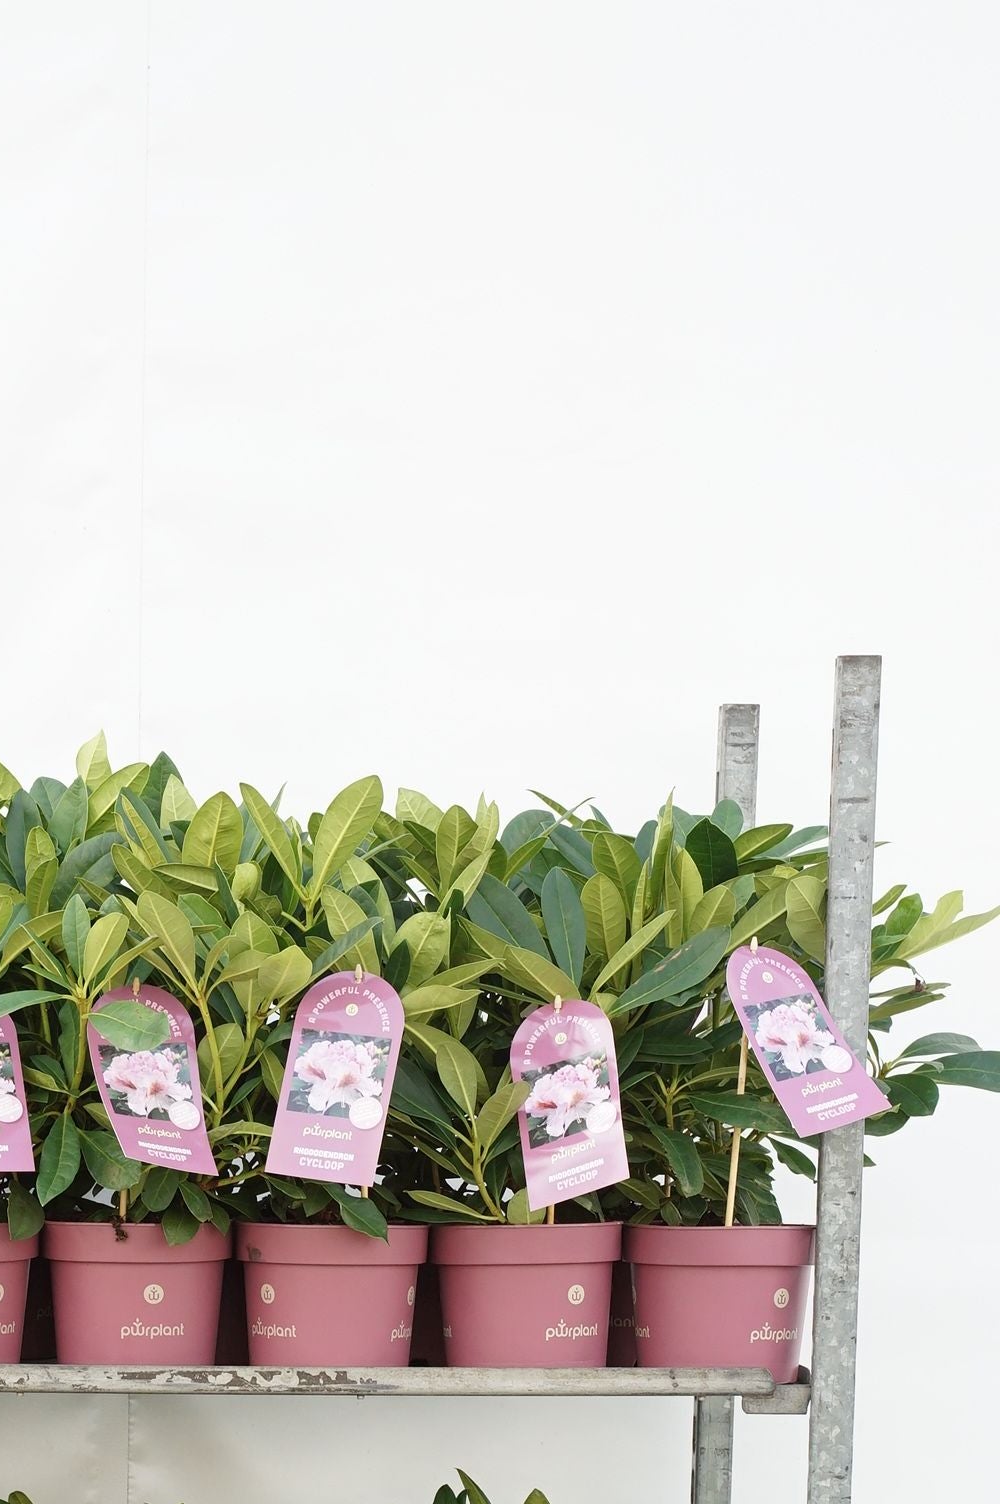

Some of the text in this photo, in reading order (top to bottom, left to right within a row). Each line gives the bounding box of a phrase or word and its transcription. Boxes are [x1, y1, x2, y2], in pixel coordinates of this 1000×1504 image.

[739, 956, 763, 993] POWERFUL
[764, 957, 806, 990] PRESENCE
[312, 986, 360, 1015] POWERFUL
[362, 989, 391, 1033] PRESENCE
[524, 1015, 563, 1056] POWERFUL
[817, 1102, 857, 1121] CYCLOOP
[147, 1150, 188, 1164] CYCLOOP
[299, 1157, 346, 1172] CYCLOOP
[556, 1170, 599, 1192] CYCLOOP
